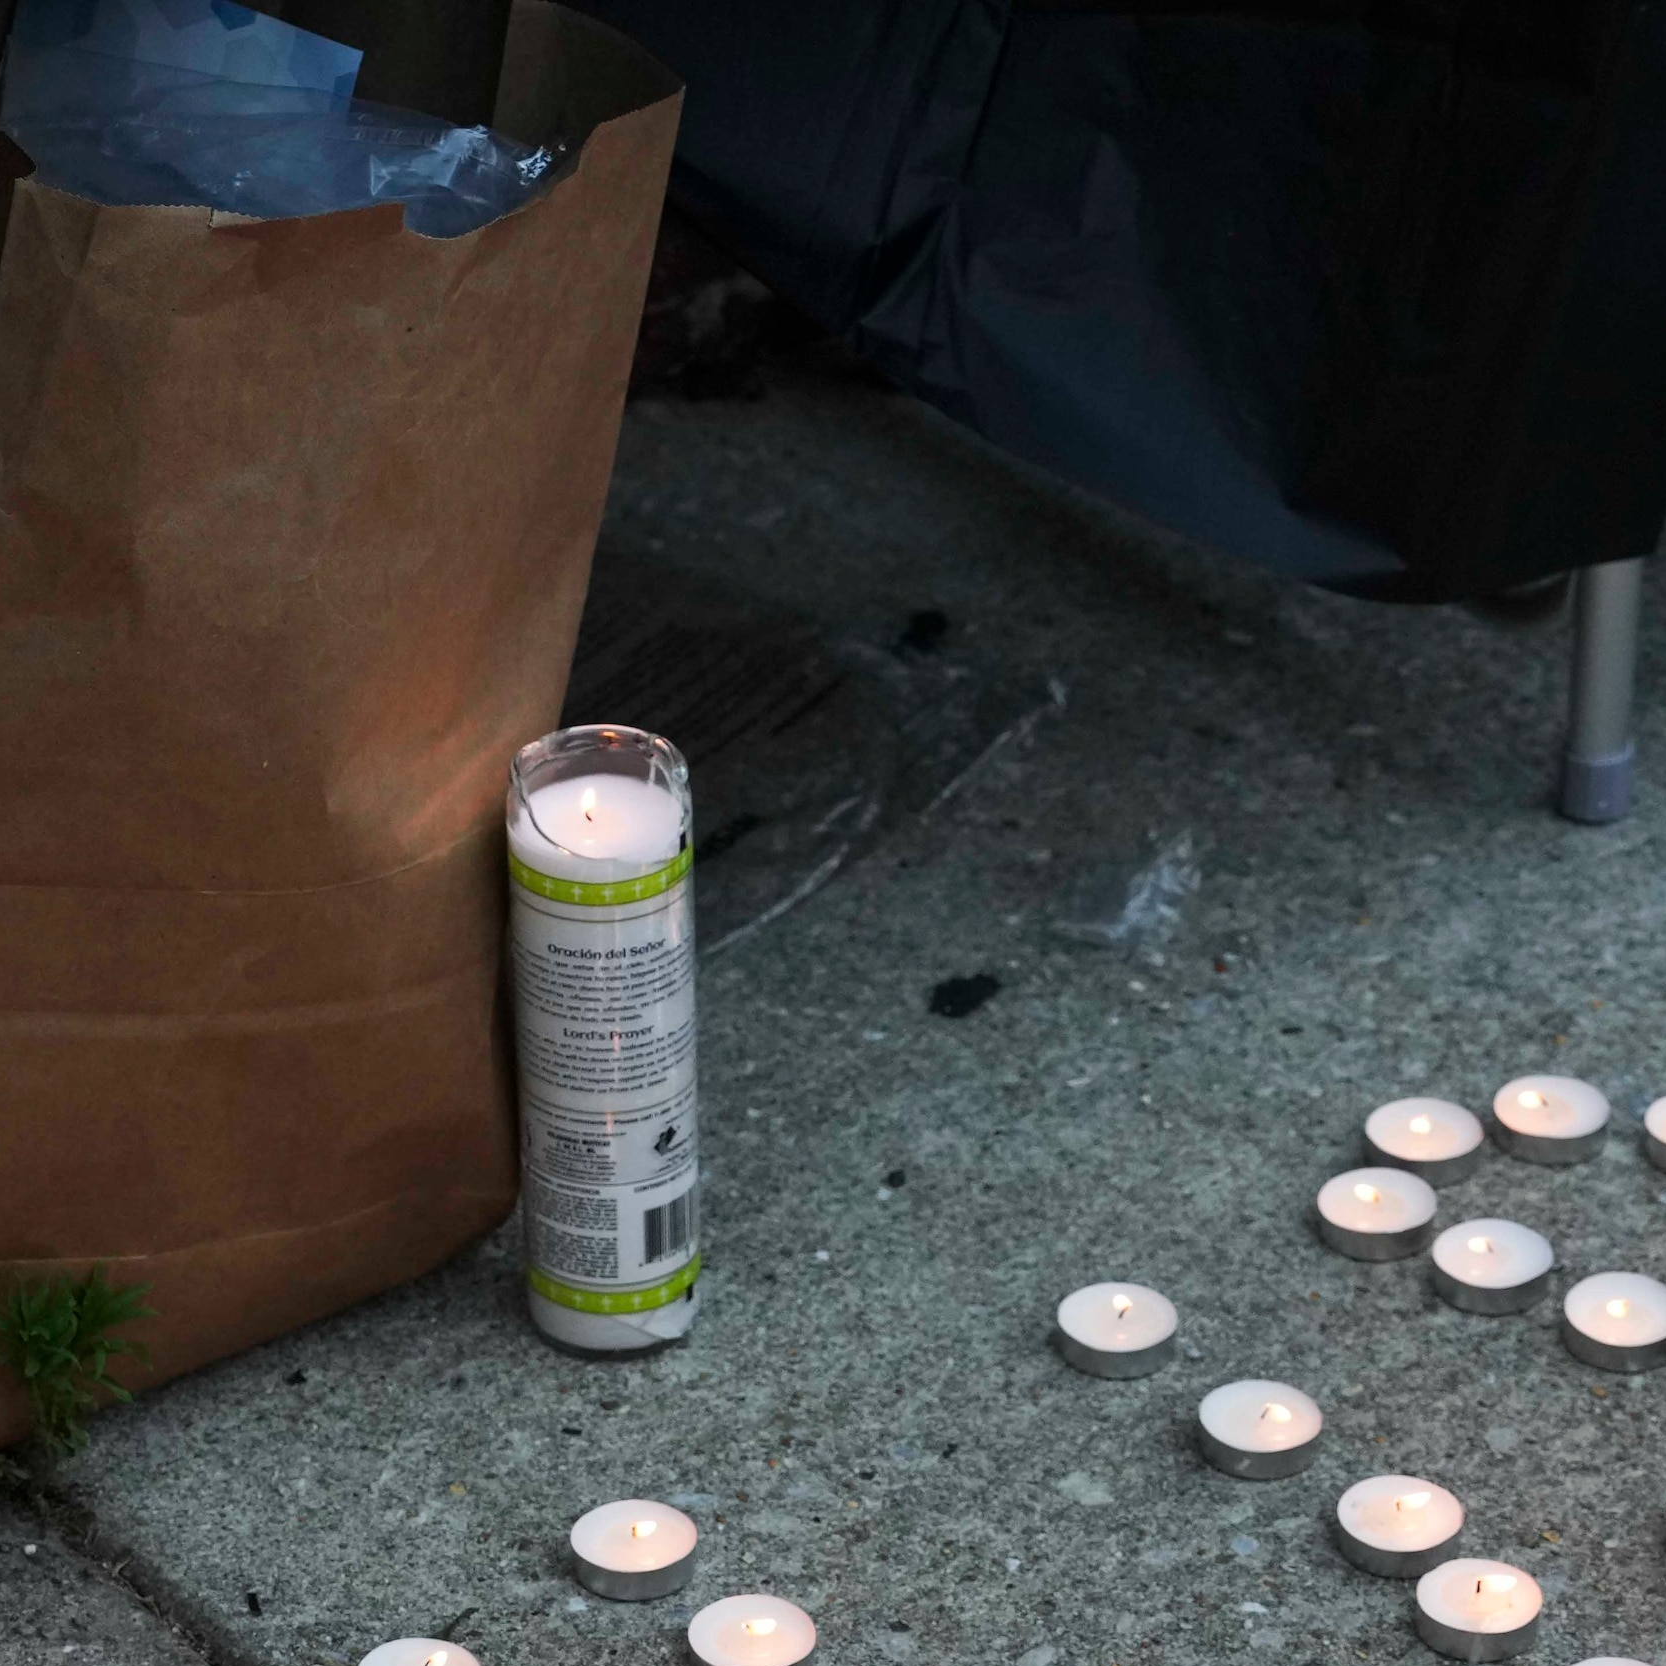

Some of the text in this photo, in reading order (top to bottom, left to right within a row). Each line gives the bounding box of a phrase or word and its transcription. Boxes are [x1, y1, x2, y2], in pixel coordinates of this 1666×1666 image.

[547, 938, 666, 960] Oración del Señor
[563, 1025, 655, 1040] Lord's Prayer
